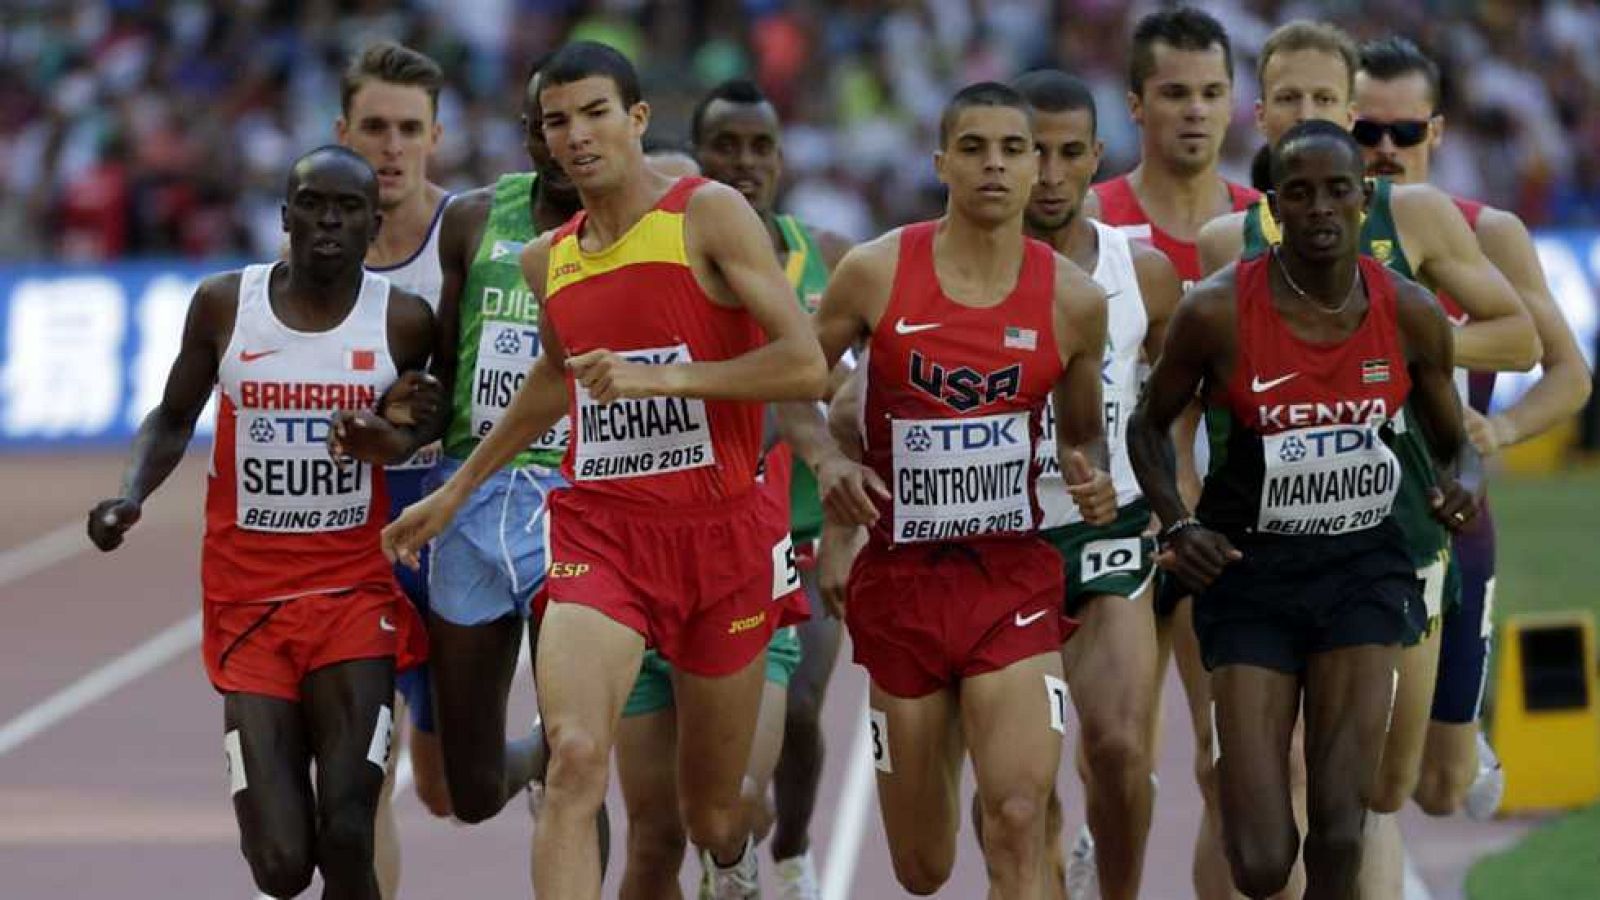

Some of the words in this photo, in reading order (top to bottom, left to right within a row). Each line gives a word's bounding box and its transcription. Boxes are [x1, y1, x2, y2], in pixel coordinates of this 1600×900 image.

[240, 381, 375, 411] BAHRAIN
[909, 350, 1022, 414] USA
[581, 395, 700, 444] MECHAAL
[1258, 398, 1387, 428] KENYA
[275, 417, 332, 443] TD
[930, 418, 1018, 451] TDK
[242, 457, 362, 496] SEUREI
[581, 452, 655, 477] BEIJING
[658, 444, 705, 470] 2015
[899, 459, 1025, 506] CENTROWITZ
[1267, 458, 1395, 509] MANANGOI
[244, 507, 322, 529] BEIJING
[324, 504, 367, 528] 2015
[901, 516, 981, 540] BEIJING
[983, 508, 1024, 535] 2015
[1265, 514, 1347, 536] BEIJING
[551, 561, 590, 578] ESP
[1086, 548, 1133, 573] 10
